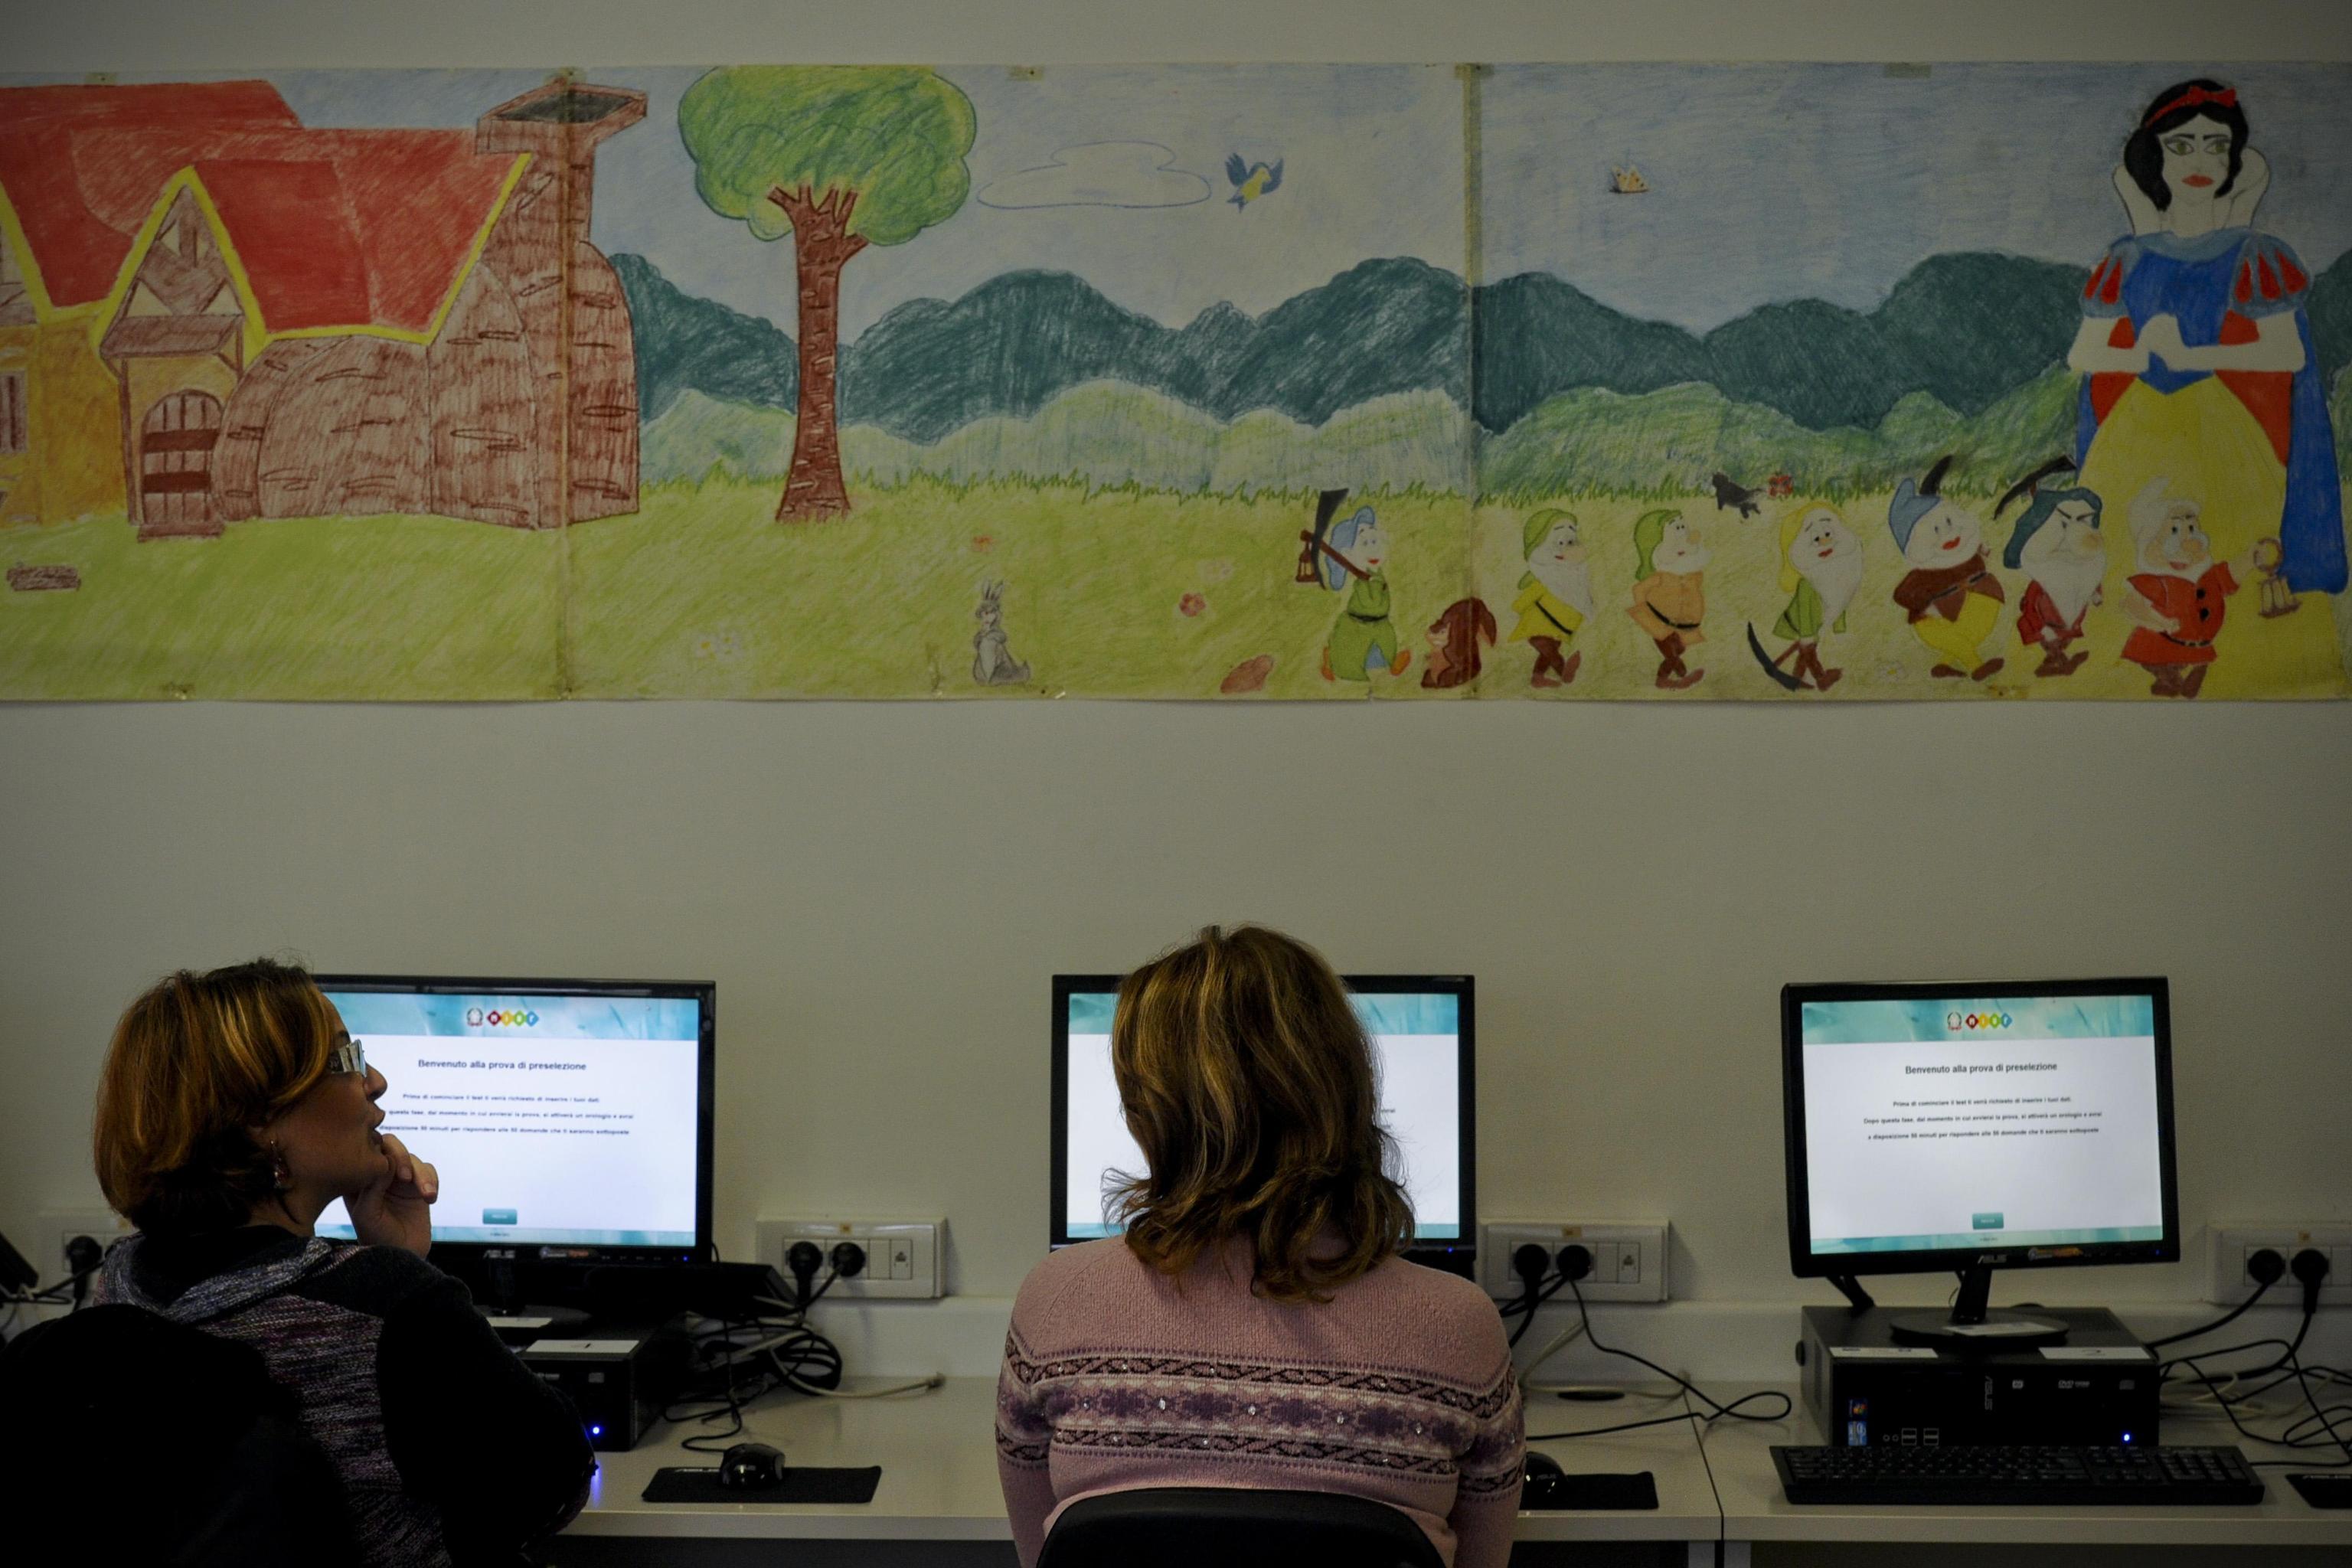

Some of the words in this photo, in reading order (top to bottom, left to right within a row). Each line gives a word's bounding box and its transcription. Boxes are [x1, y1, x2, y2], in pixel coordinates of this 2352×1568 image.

[418, 1060, 467, 1068] Benvenuto
[488, 1062, 515, 1070] prova
[529, 1062, 586, 1070] preselezione
[1906, 1066, 1950, 1074] Benvenuto
[1970, 1064, 1994, 1074] prova
[1996, 1063, 2003, 1072] di
[2006, 1063, 2057, 1073] preselezione
[483, 1250, 515, 1259] ASUS
[1978, 1253, 2007, 1264] ASUS
[1984, 1375, 1994, 1411] ASUS
